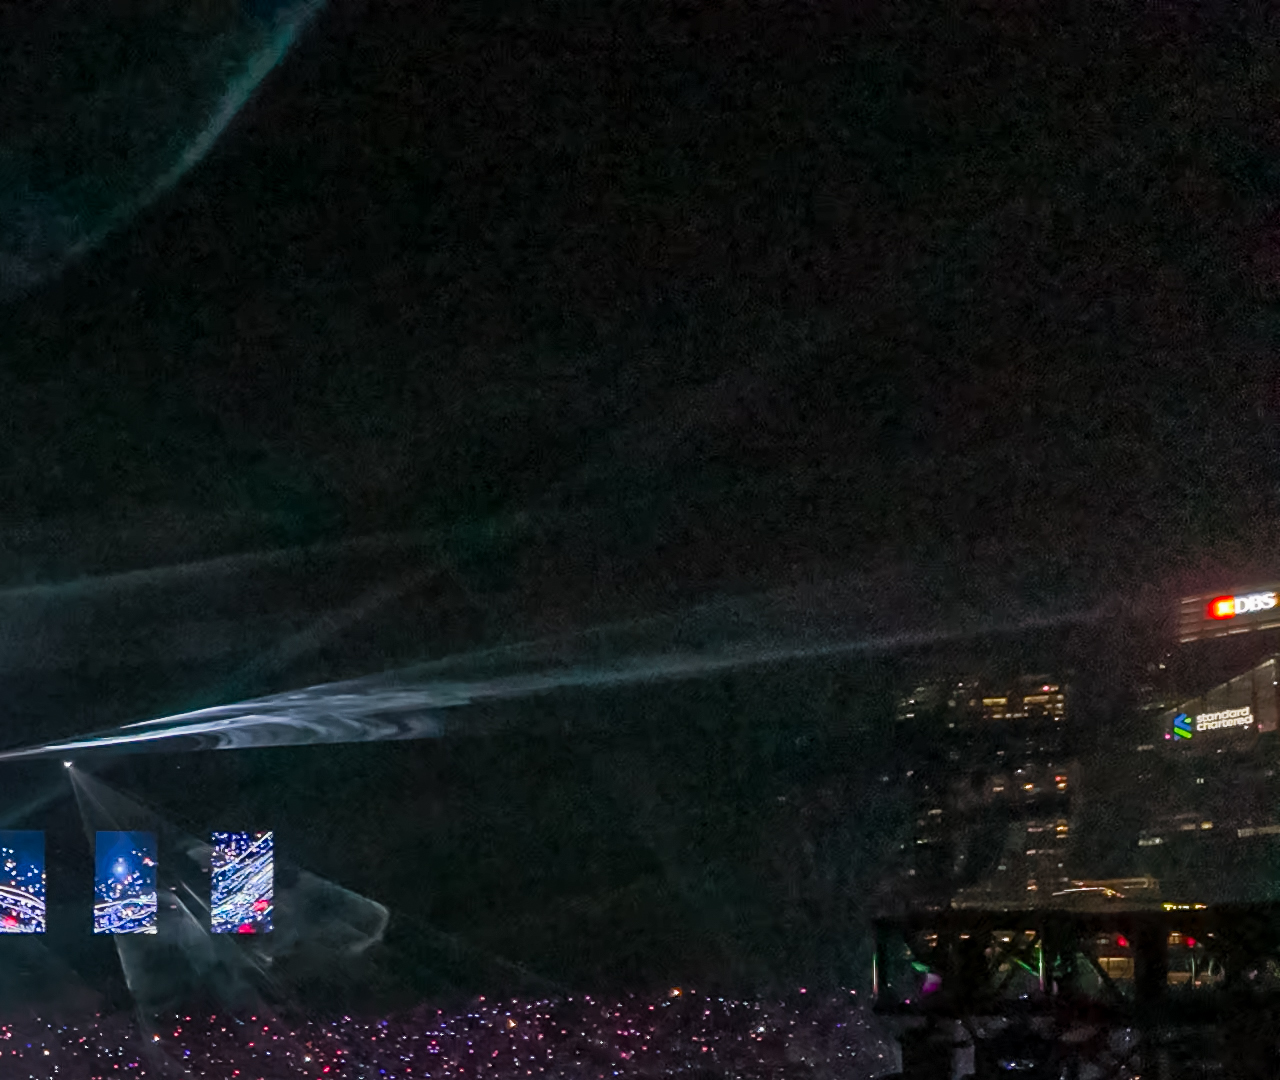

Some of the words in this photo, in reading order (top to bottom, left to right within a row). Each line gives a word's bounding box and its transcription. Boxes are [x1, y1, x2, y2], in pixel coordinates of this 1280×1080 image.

[1234, 592, 1277, 615] DBS
[1196, 706, 1250, 723] standard
[1196, 714, 1254, 731] chartered
